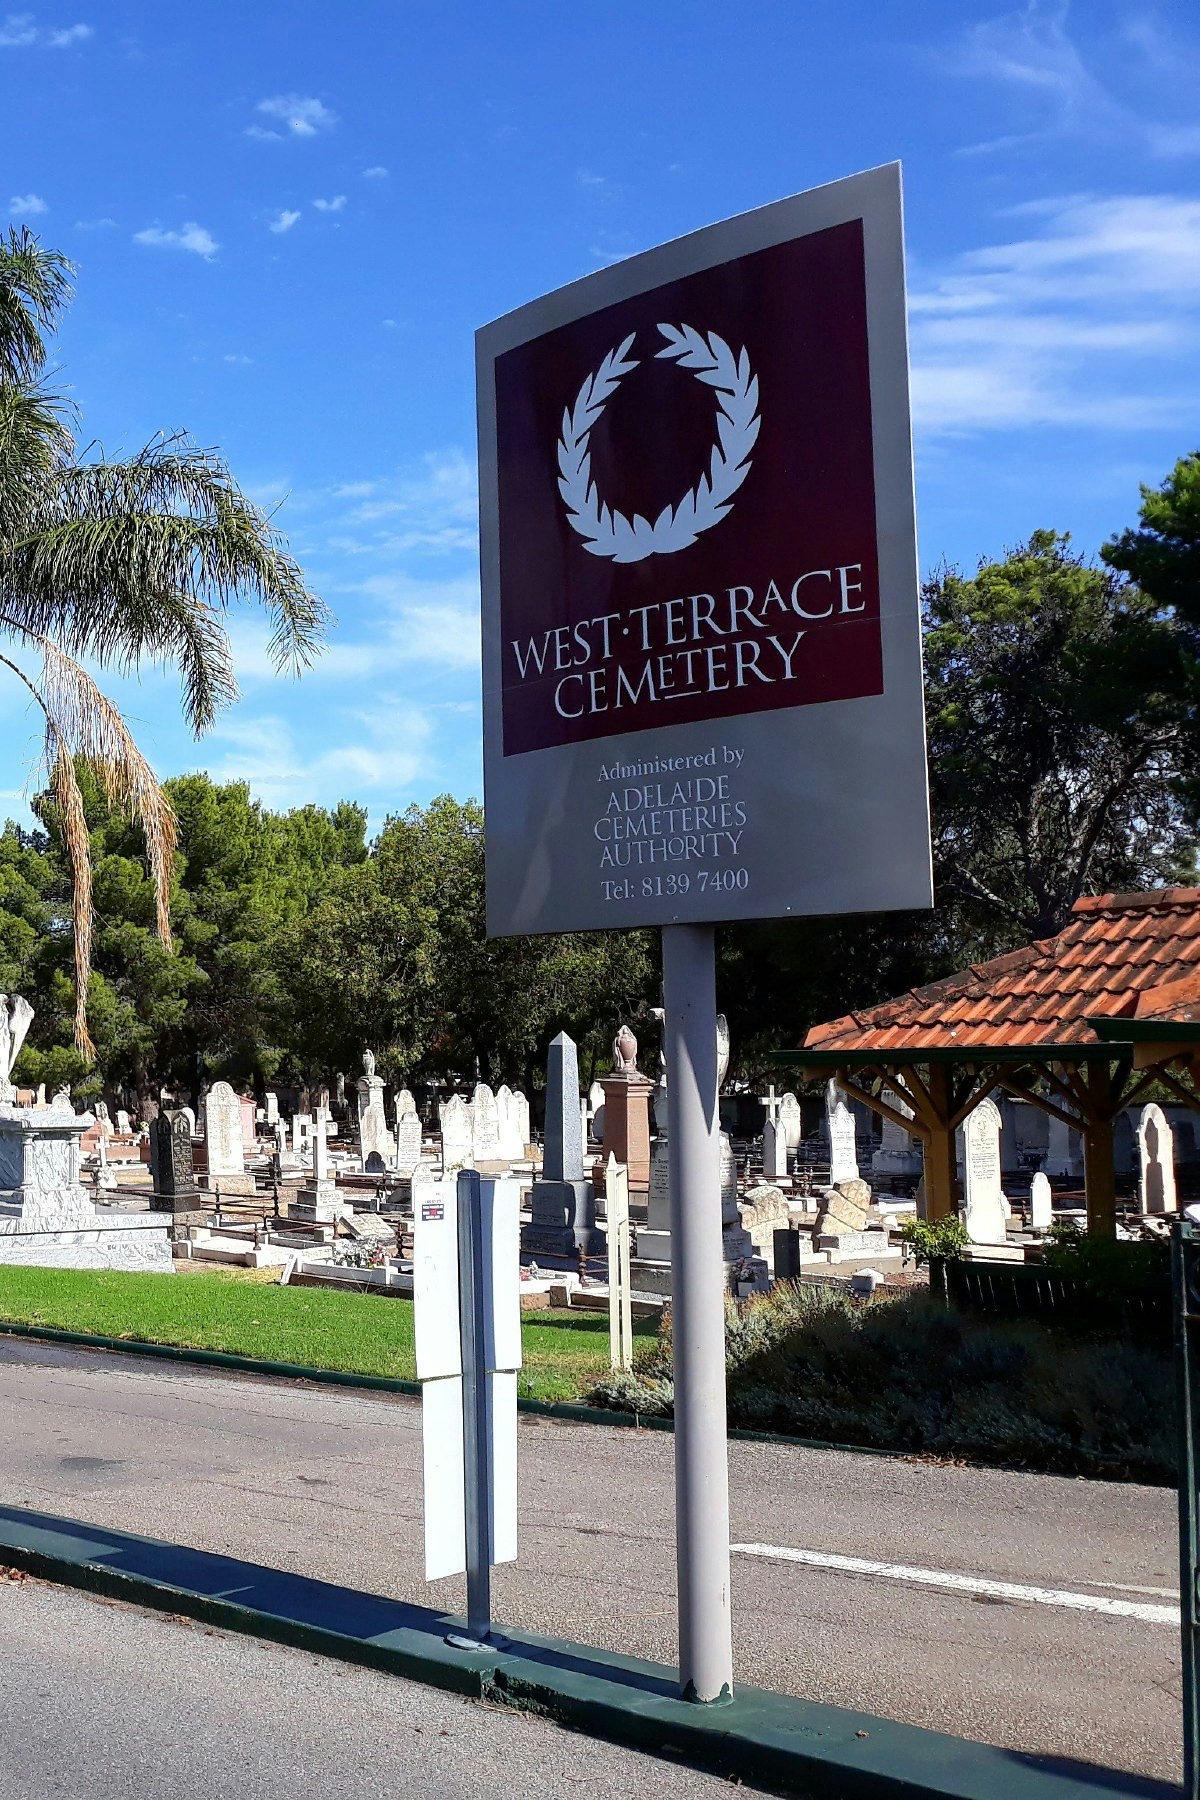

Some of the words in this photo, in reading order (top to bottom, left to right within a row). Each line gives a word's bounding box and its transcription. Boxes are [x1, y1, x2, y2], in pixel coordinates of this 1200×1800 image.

[554, 631, 808, 719] CEMETERY
[597, 749, 716, 782] Administered
[723, 747, 744, 768] by
[606, 775, 729, 814] ADELAIDE
[594, 801, 746, 841] CEMETERIES
[599, 831, 744, 868] AUTHORITY
[601, 881, 634, 900] Tel:
[642, 874, 689, 897] 8139
[697, 868, 749, 892] 7400
